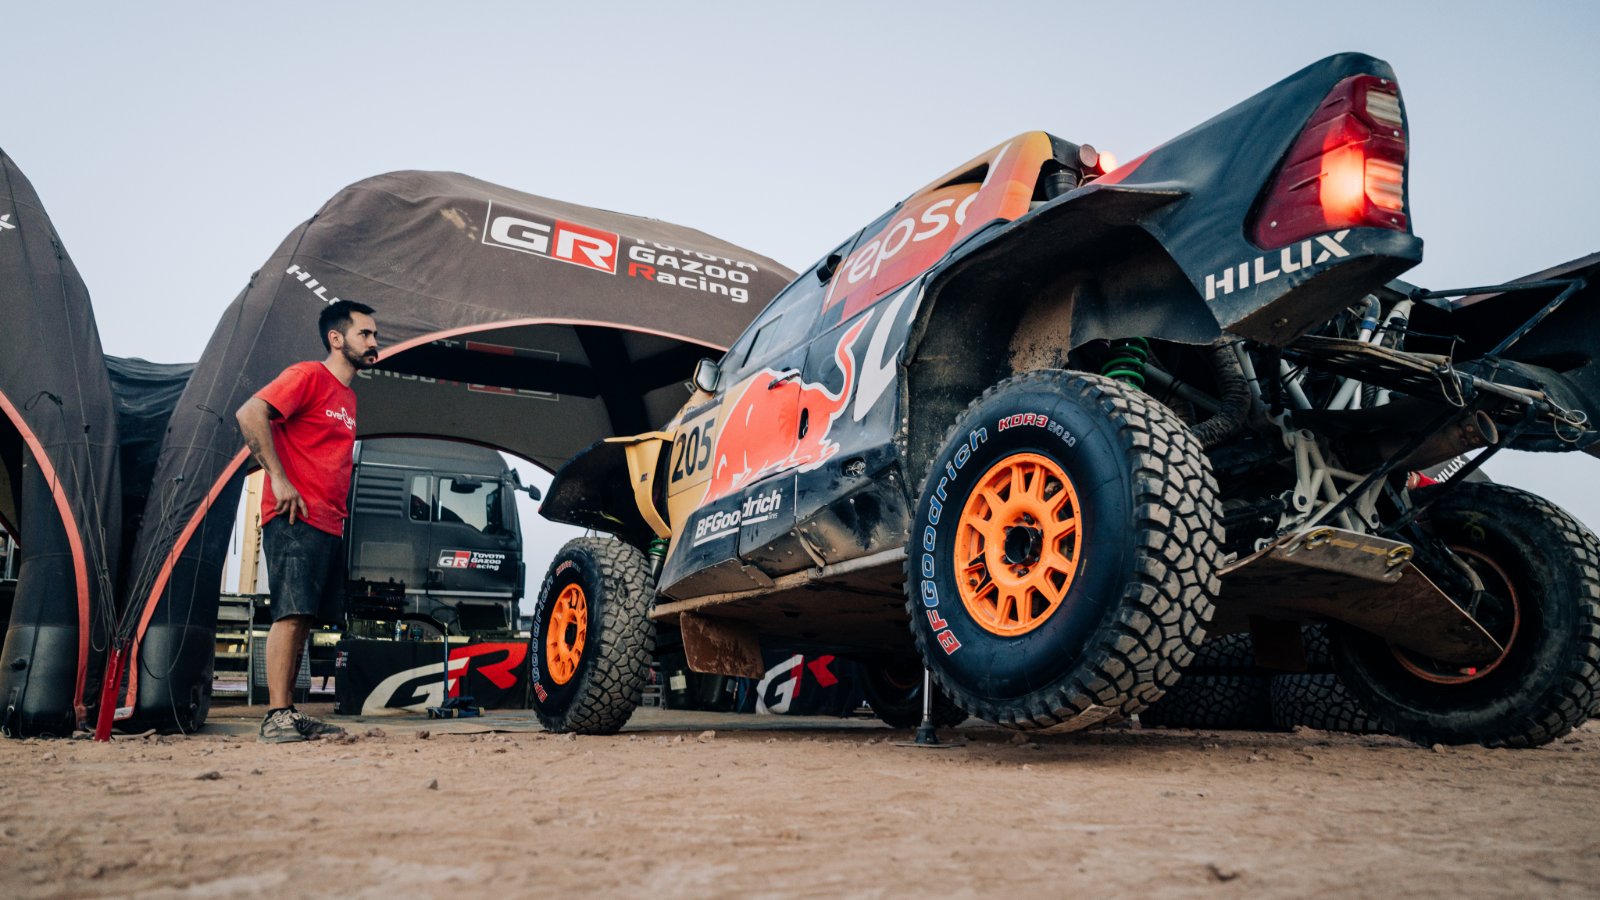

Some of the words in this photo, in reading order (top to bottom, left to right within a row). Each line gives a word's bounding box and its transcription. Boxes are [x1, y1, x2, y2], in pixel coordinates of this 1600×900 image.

[490, 216, 614, 271] GR
[628, 245, 749, 285] GAZOO
[1205, 229, 1350, 301] HILUX
[628, 262, 749, 304] Racing
[672, 418, 715, 484] 205
[695, 489, 782, 540] BFGoodrich
[439, 556, 468, 568] GR
[470, 557, 502, 565] GAZOO
[472, 551, 506, 560] TOYOTA
[921, 426, 988, 655] BFGoodrich
[469, 562, 500, 571] Racing
[361, 642, 529, 716] GR
